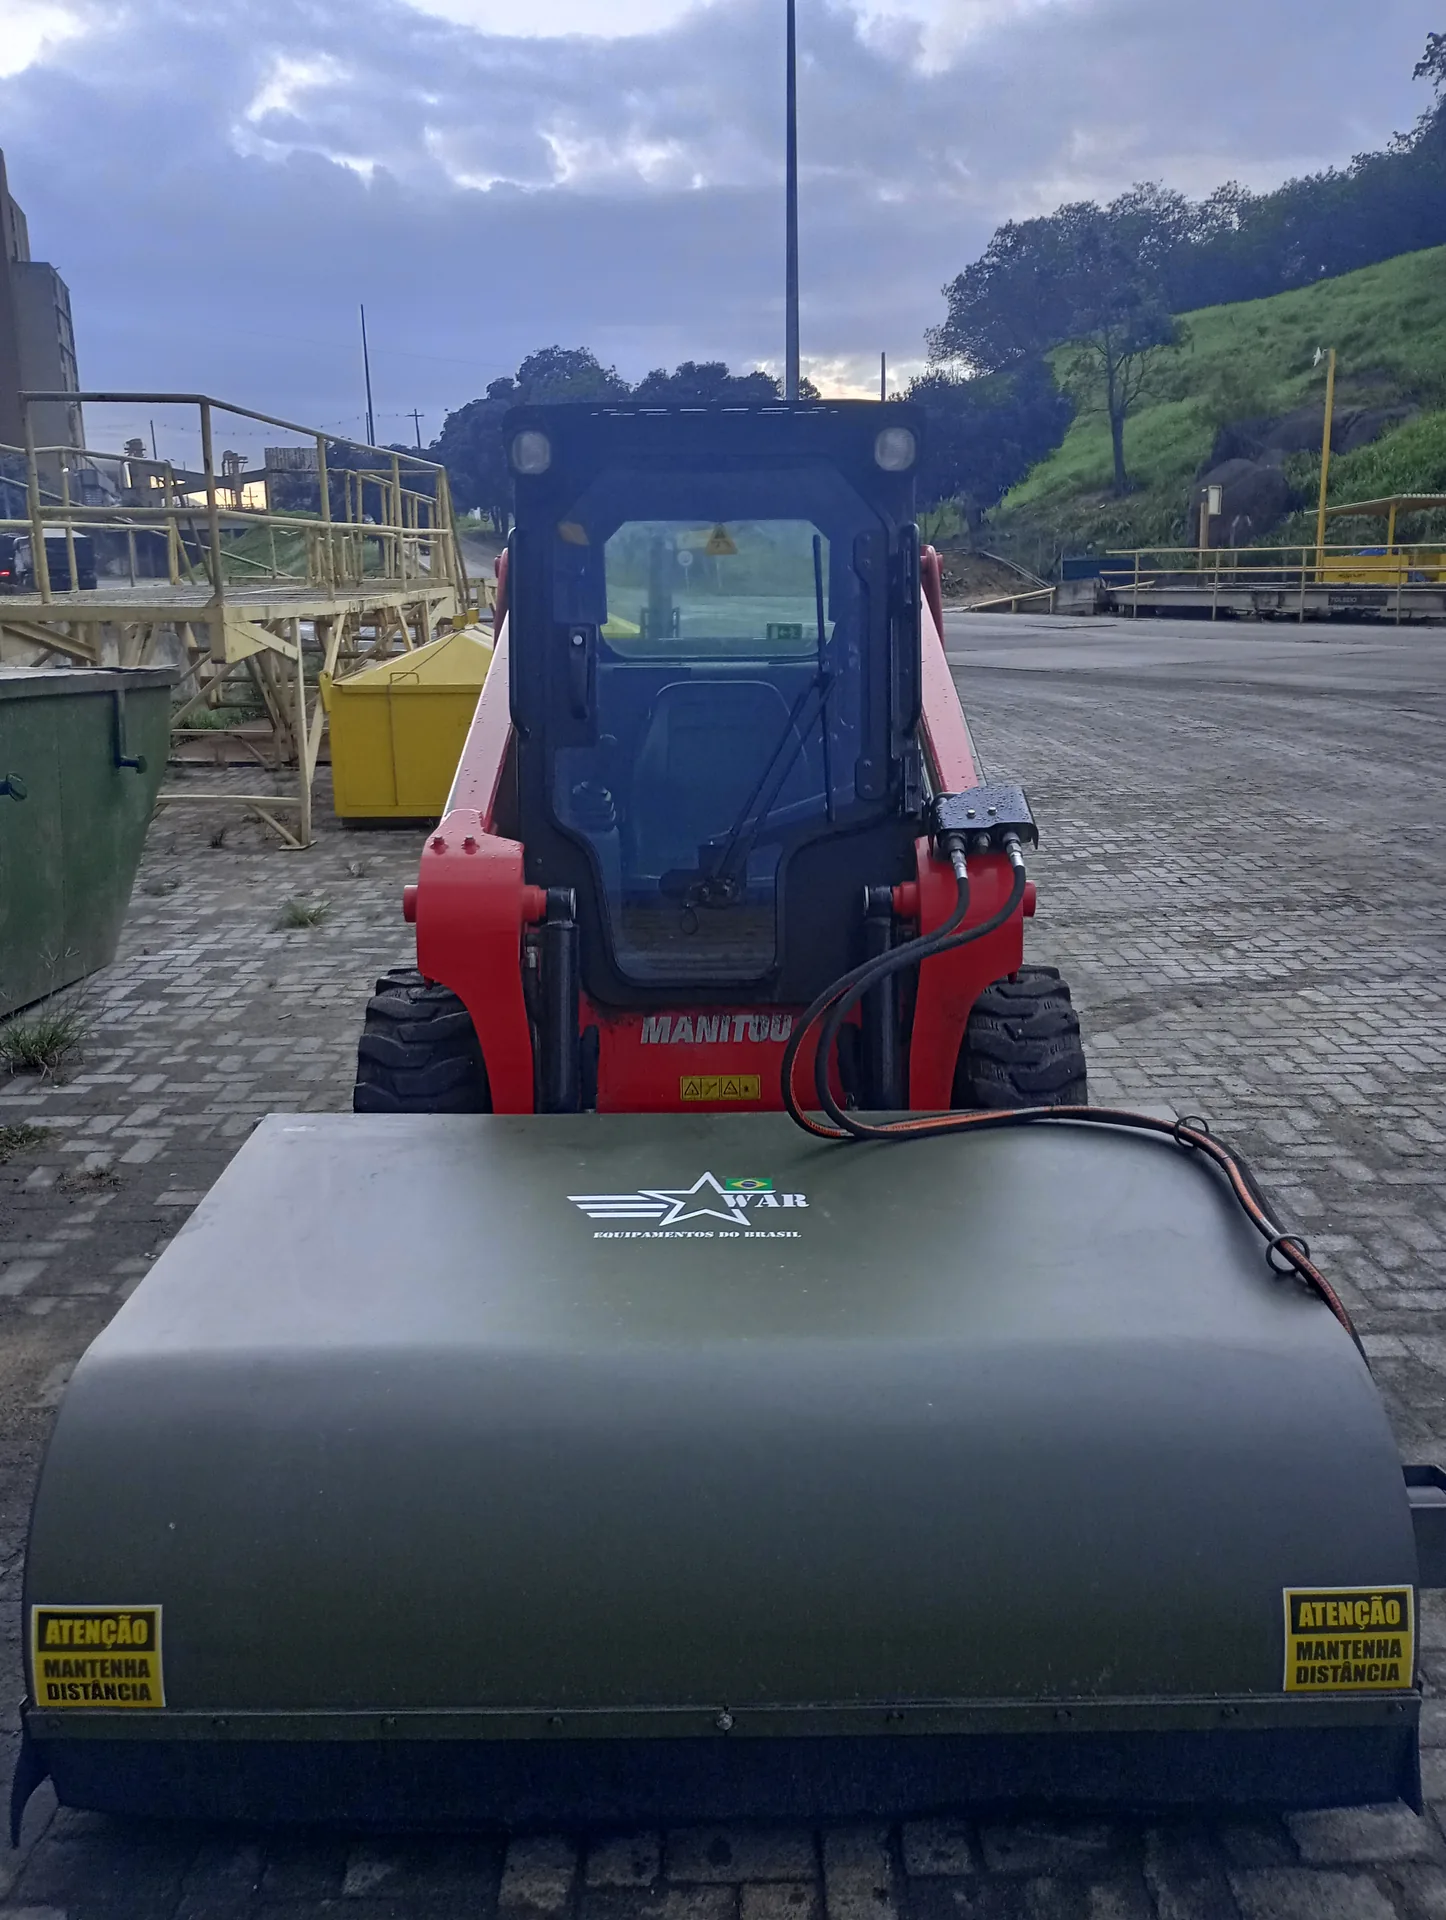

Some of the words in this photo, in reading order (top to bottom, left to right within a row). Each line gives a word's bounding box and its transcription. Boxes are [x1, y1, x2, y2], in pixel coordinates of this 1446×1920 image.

[640, 1014, 793, 1044] MANITOU
[721, 1193, 810, 1208] WAR
[593, 1231, 714, 1239] EQUIPAMENTOS
[1298, 1595, 1401, 1630] ATENÇÃO
[45, 1615, 148, 1649] ATENÇÃO
[1296, 1638, 1402, 1661] MANTENHA
[43, 1658, 151, 1679] MANTENHA
[1296, 1661, 1400, 1684] DISTÂNCIA
[46, 1680, 152, 1701] DISTÂNCIA
